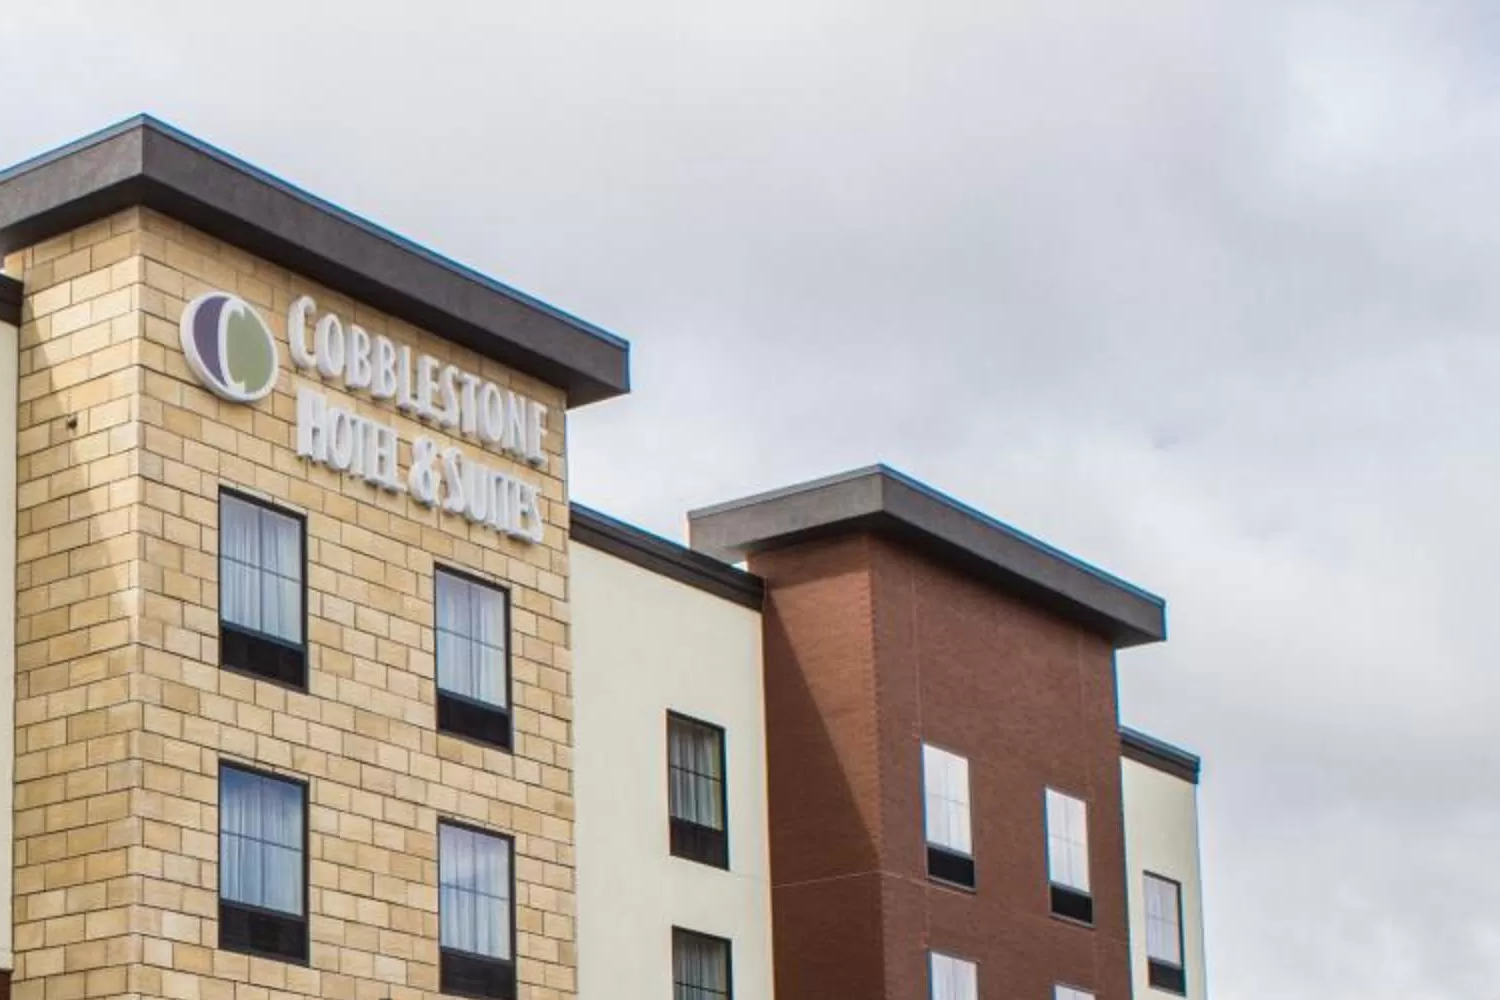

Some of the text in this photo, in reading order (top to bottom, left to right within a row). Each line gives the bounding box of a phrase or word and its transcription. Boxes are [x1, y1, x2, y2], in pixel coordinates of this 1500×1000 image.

[289, 295, 547, 466] COBBLESTONE
[296, 387, 543, 545] HOTEL & SUITES
